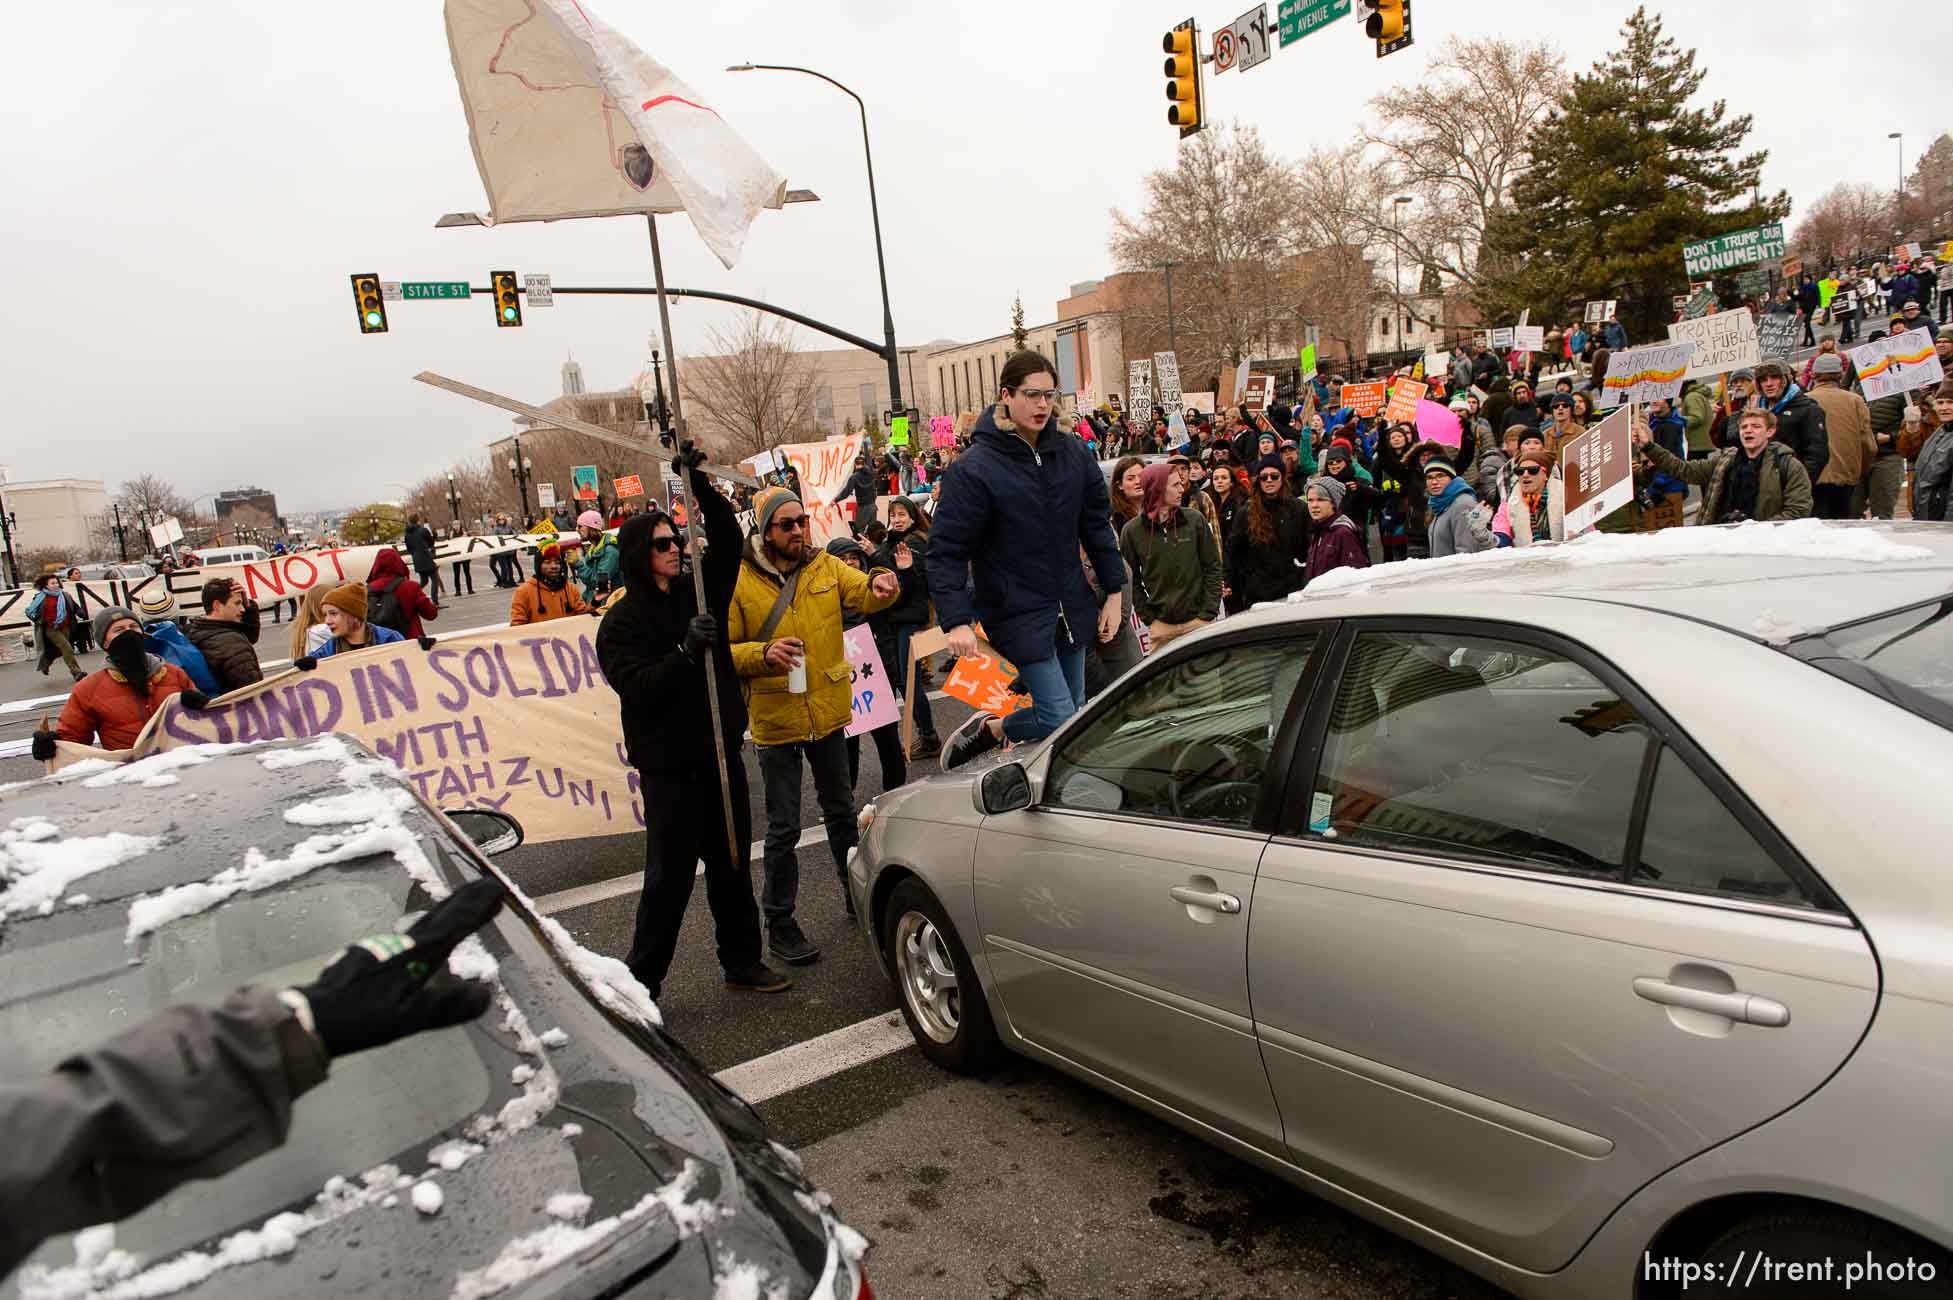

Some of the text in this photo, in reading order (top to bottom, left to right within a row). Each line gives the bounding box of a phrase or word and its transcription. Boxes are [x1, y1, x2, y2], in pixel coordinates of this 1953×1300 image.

[1294, 0, 1319, 15] NOR
[1297, 4, 1330, 33] AVENUE
[1683, 226, 1782, 259] DON'T TRUMP OUR
[1685, 240, 1785, 275] MONUMENTS
[407, 285, 445, 297] STATE
[451, 284, 466, 296] ST.
[528, 288, 551, 297] BLOCK
[535, 278, 550, 287] NOT
[1675, 311, 1746, 341] PROTECT
[1711, 327, 1757, 350] PUBLIC
[1162, 390, 1182, 402] FUCK
[1164, 402, 1184, 415] TRUMP
[0, 570, 203, 630] ZNKE
[243, 548, 350, 599] NOT
[163, 677, 343, 745] STAND
[350, 657, 419, 725] IN
[499, 756, 612, 822] ZUNI
